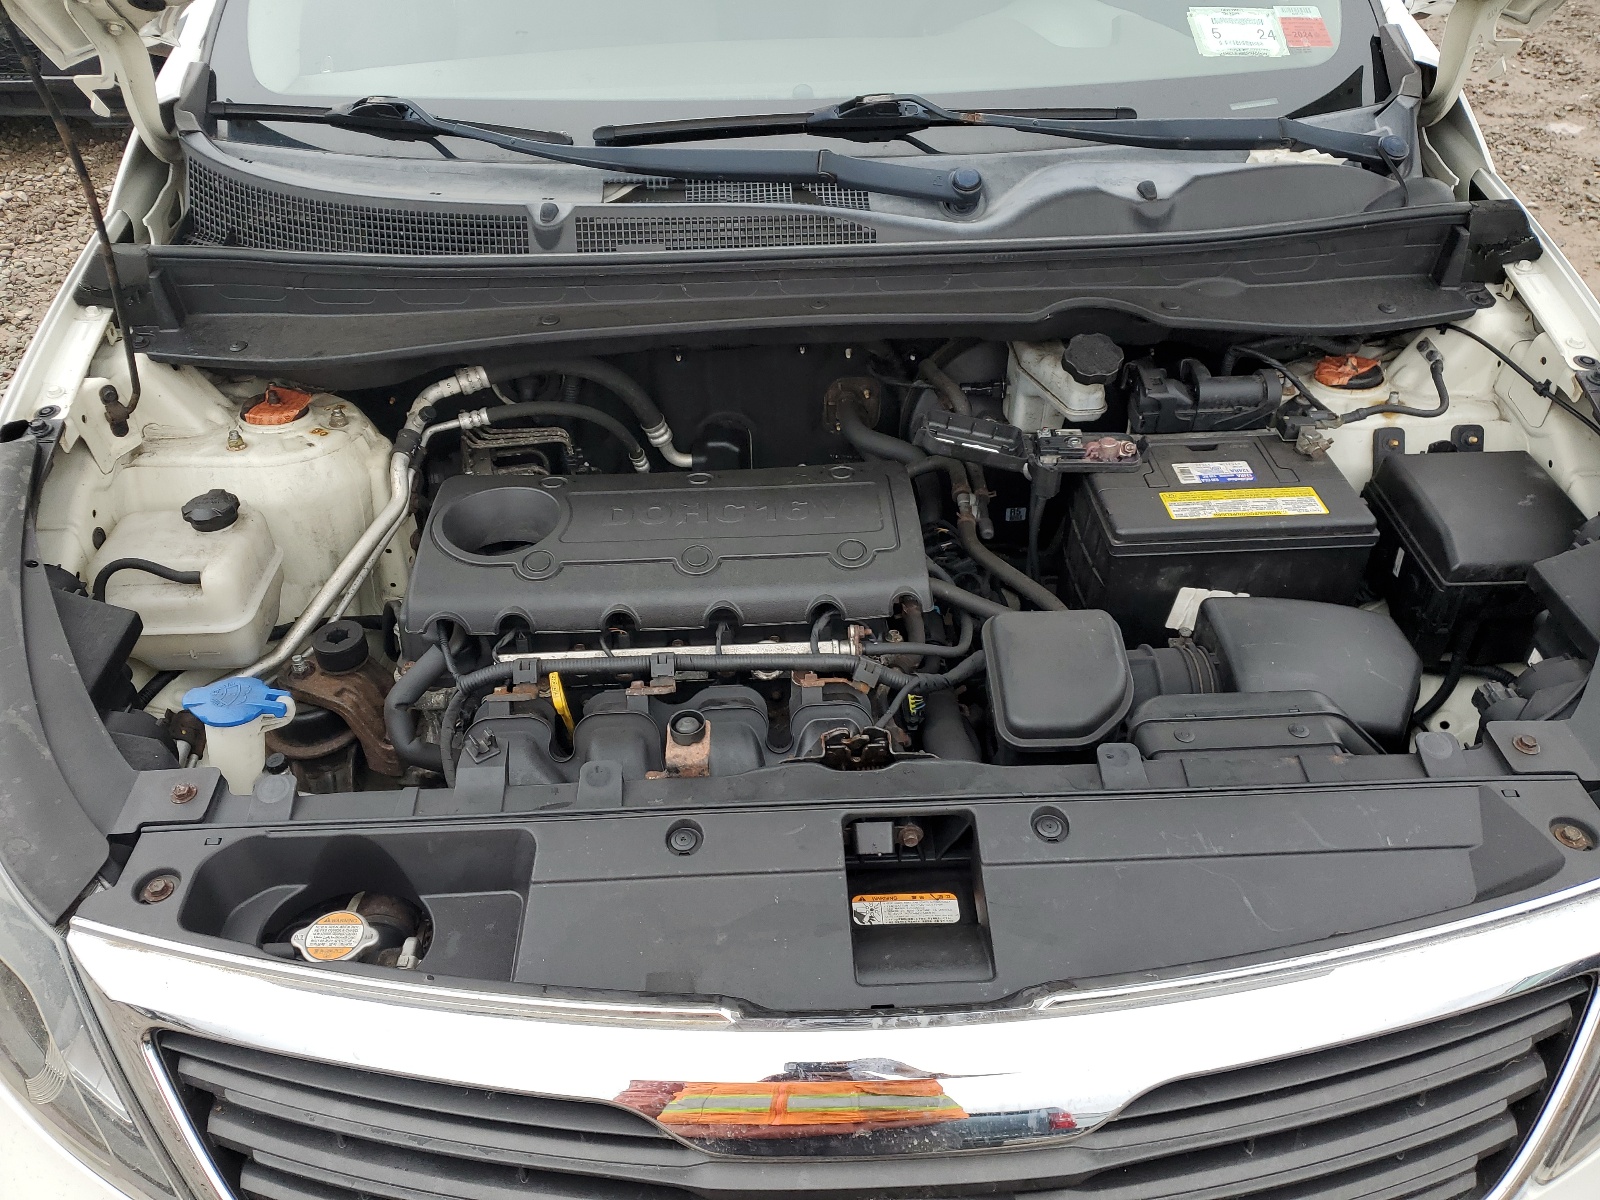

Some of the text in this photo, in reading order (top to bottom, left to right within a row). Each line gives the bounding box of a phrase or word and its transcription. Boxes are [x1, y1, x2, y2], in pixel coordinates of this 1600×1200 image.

[1211, 27, 1277, 41] 5 24
[1291, 30, 1314, 38] 2024
